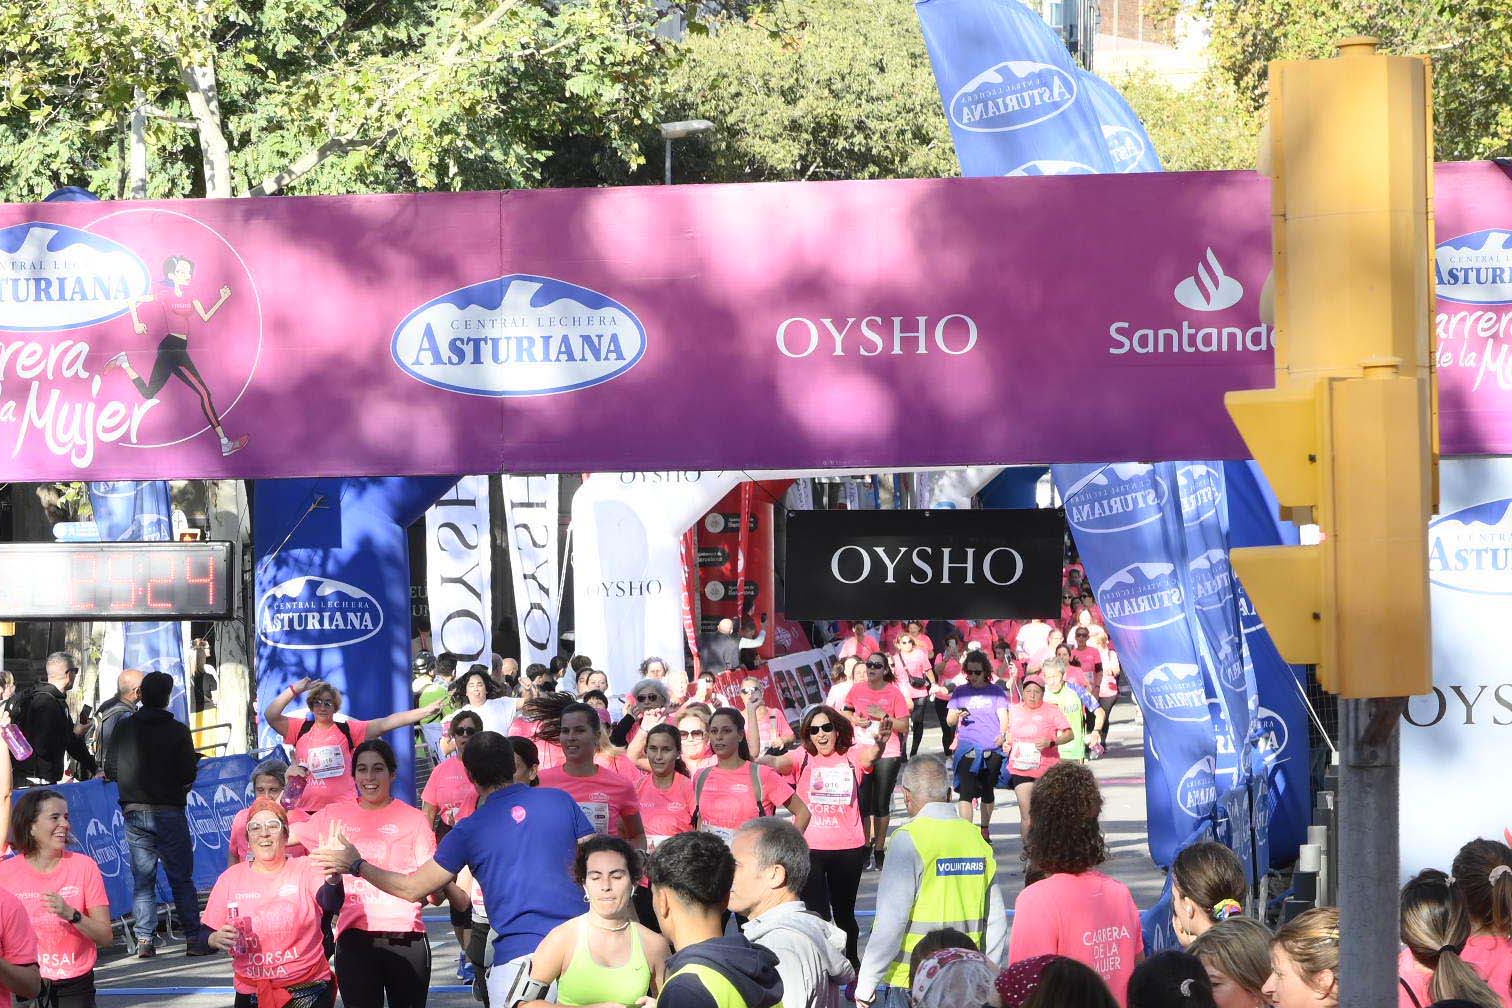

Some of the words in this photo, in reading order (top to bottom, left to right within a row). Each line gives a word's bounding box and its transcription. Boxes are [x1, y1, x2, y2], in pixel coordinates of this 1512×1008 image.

[450, 317, 528, 331] CENTRAL
[537, 314, 618, 329] LECHERA
[775, 313, 978, 359] OYSHO
[411, 322, 626, 368] ASTURIANA
[12, 373, 160, 469] Mujer
[830, 545, 1024, 587] OYSHO
[262, 606, 374, 634] ASTURIANA
[1083, 926, 1130, 945] CARRERA
[1107, 943, 1119, 956] LA
